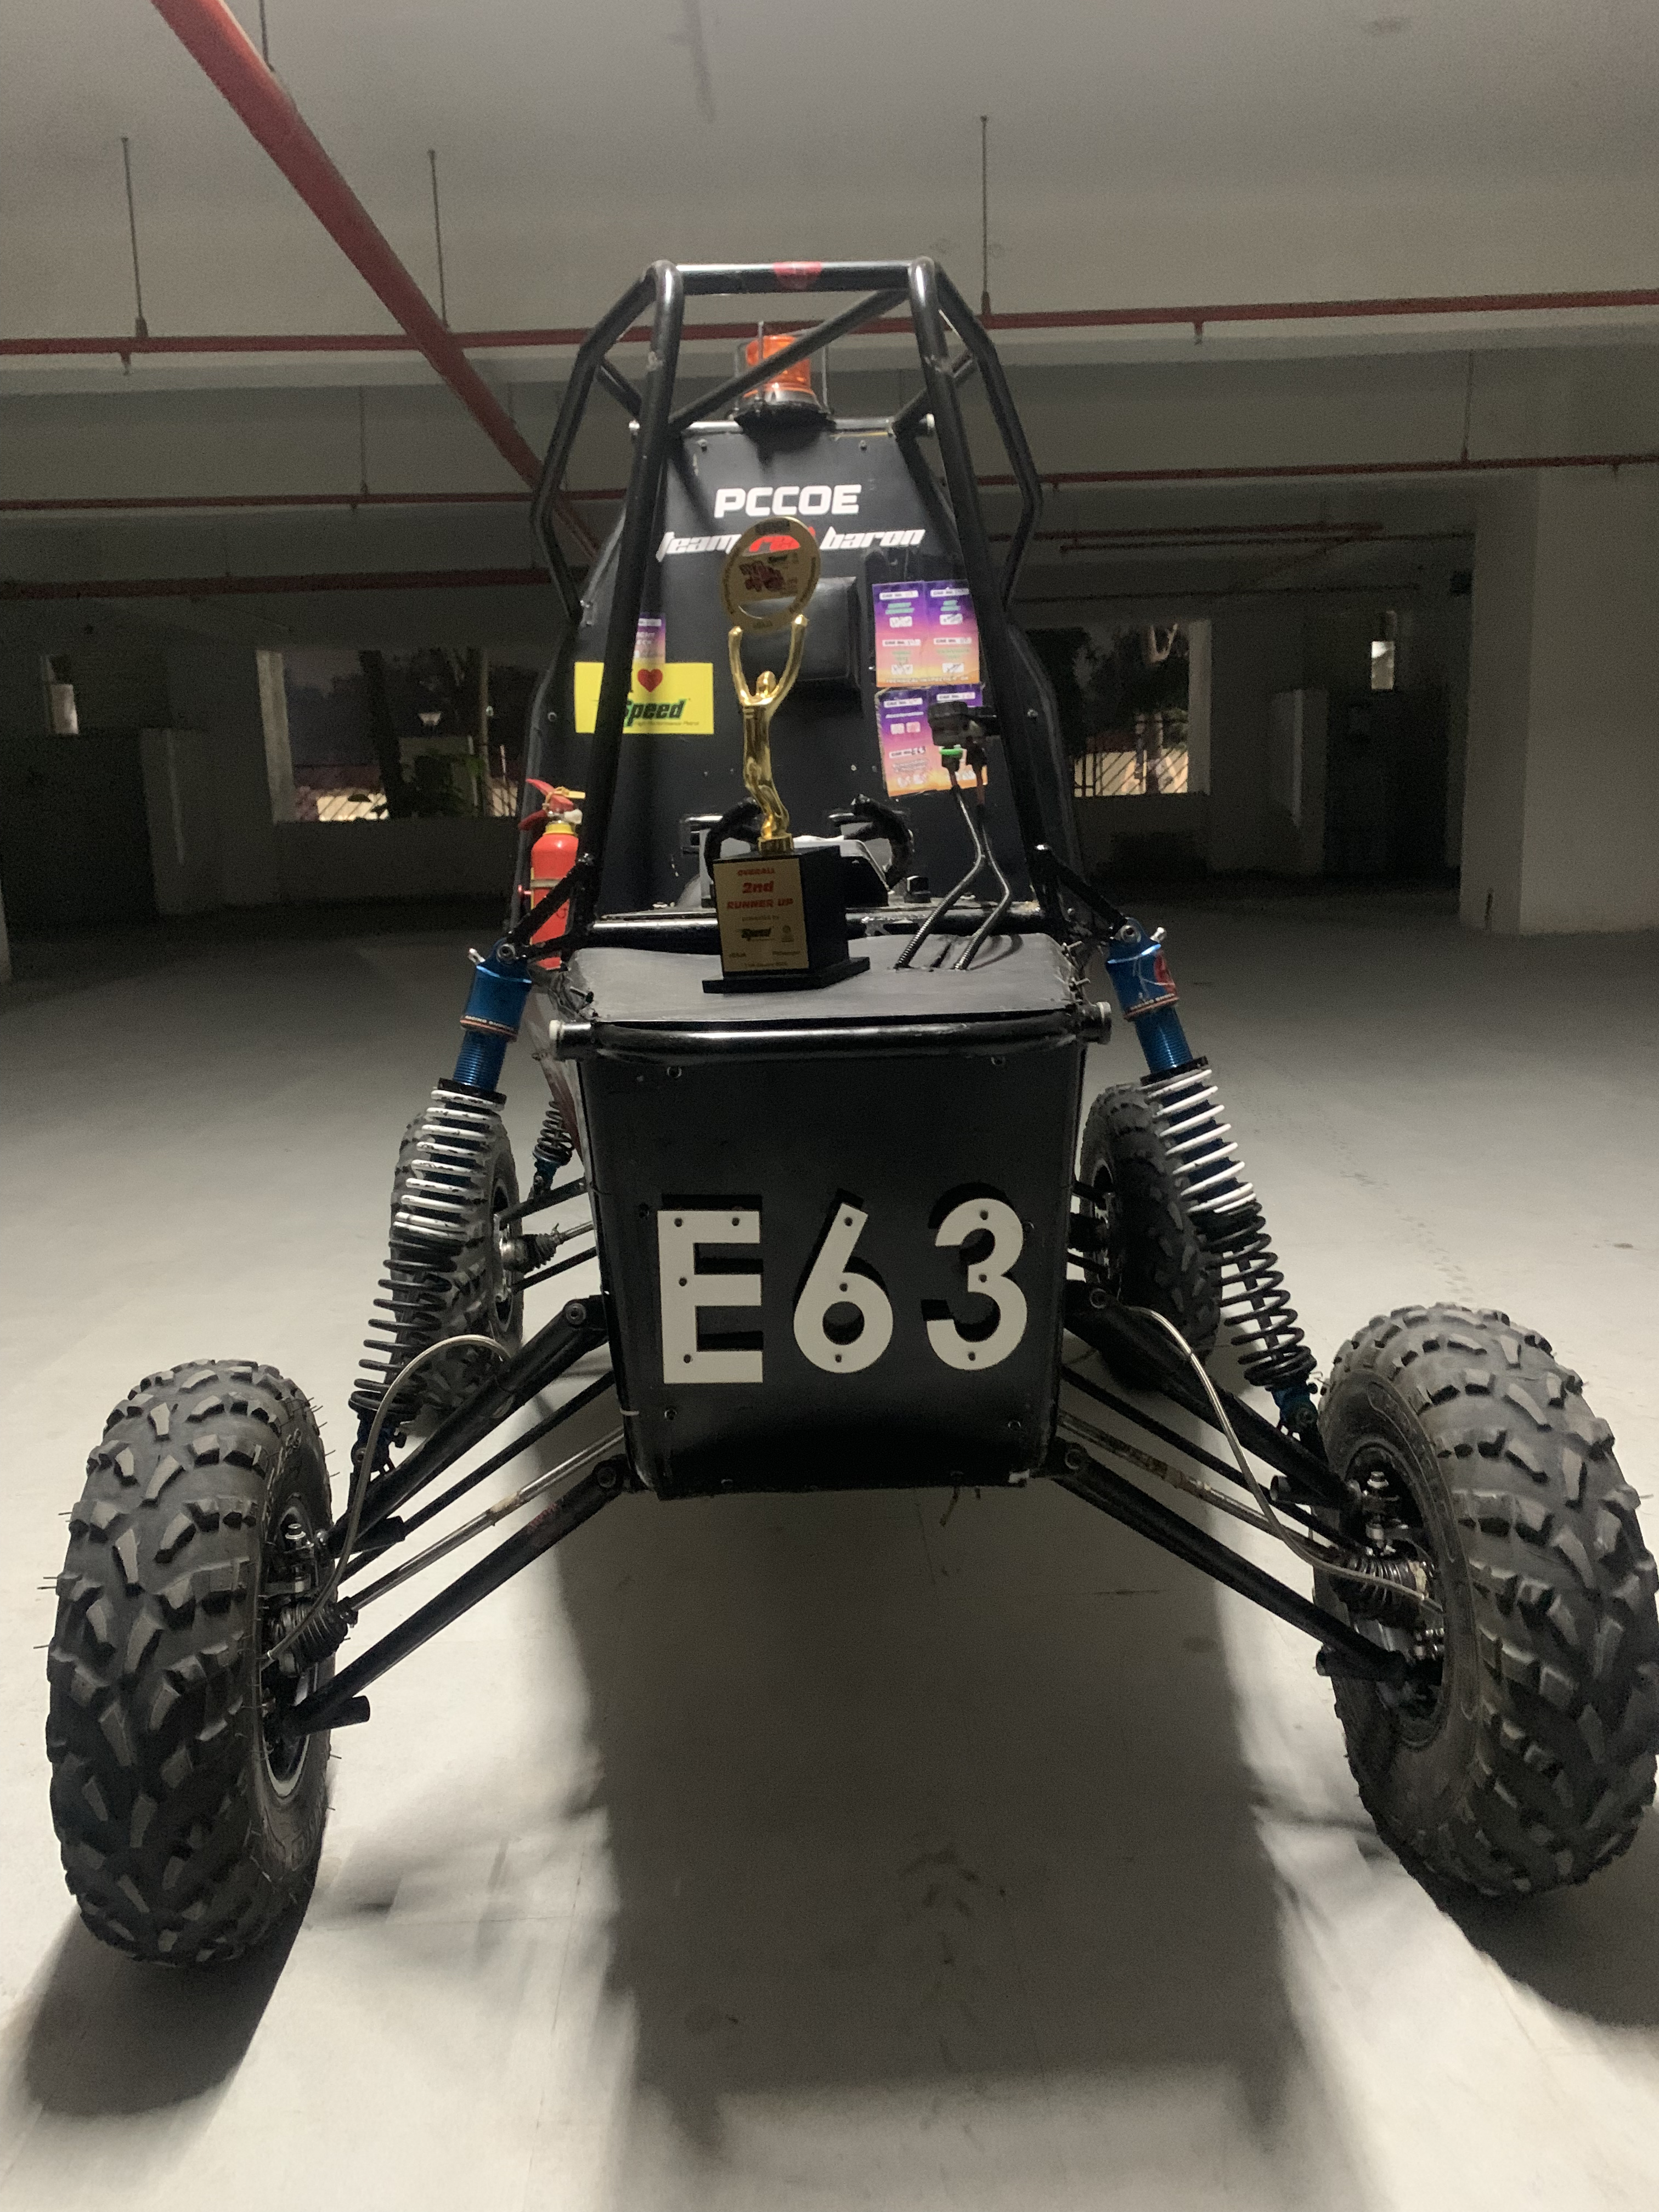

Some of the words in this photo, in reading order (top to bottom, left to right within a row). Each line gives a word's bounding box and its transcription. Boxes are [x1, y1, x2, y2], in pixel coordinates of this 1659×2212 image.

[714, 484, 862, 518] PCCOE
[820, 526, 926, 550] baron
[742, 880, 774, 894] 2nd
[726, 899, 774, 910] RUNNER
[777, 898, 794, 907] UP
[657, 1198, 1028, 1384] E63
